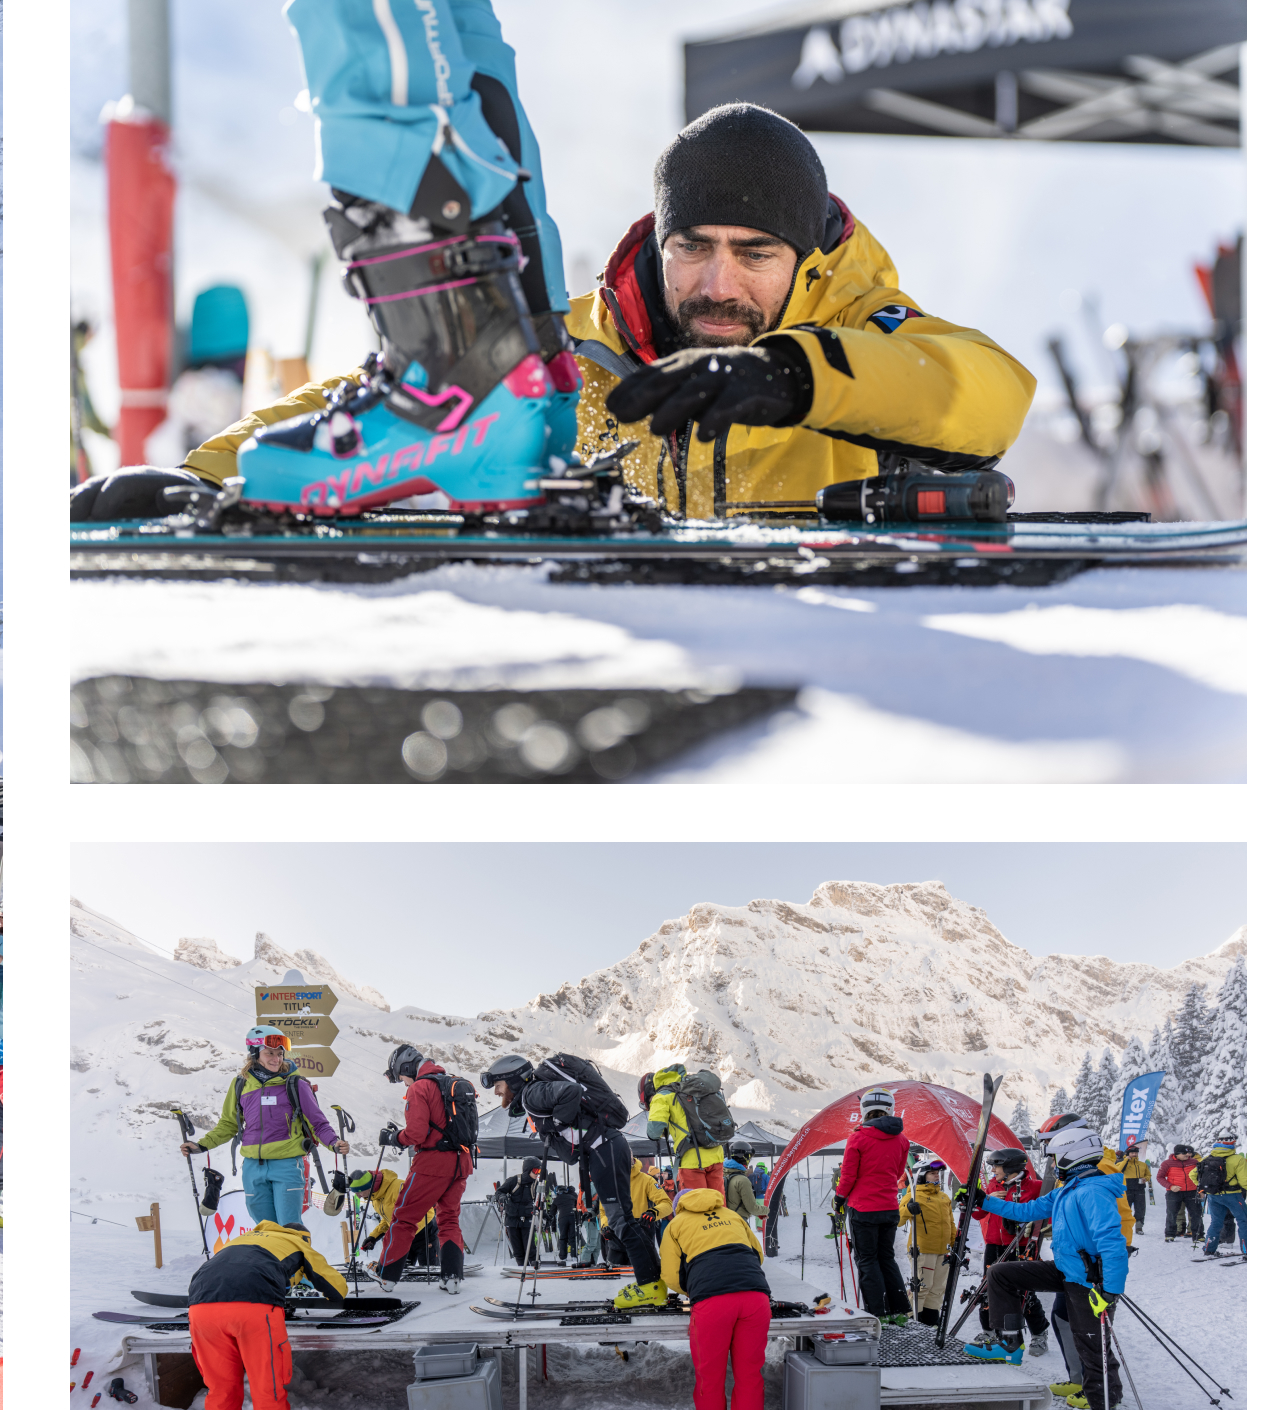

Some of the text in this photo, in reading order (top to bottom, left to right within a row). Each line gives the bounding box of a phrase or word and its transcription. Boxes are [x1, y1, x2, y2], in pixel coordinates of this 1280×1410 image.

[300, 411, 500, 505] DYNAFIT
[270, 992, 323, 1001] INTERSPORT
[268, 1018, 320, 1027] STÖCKLI
[702, 1220, 732, 1231] BÄCHLI
